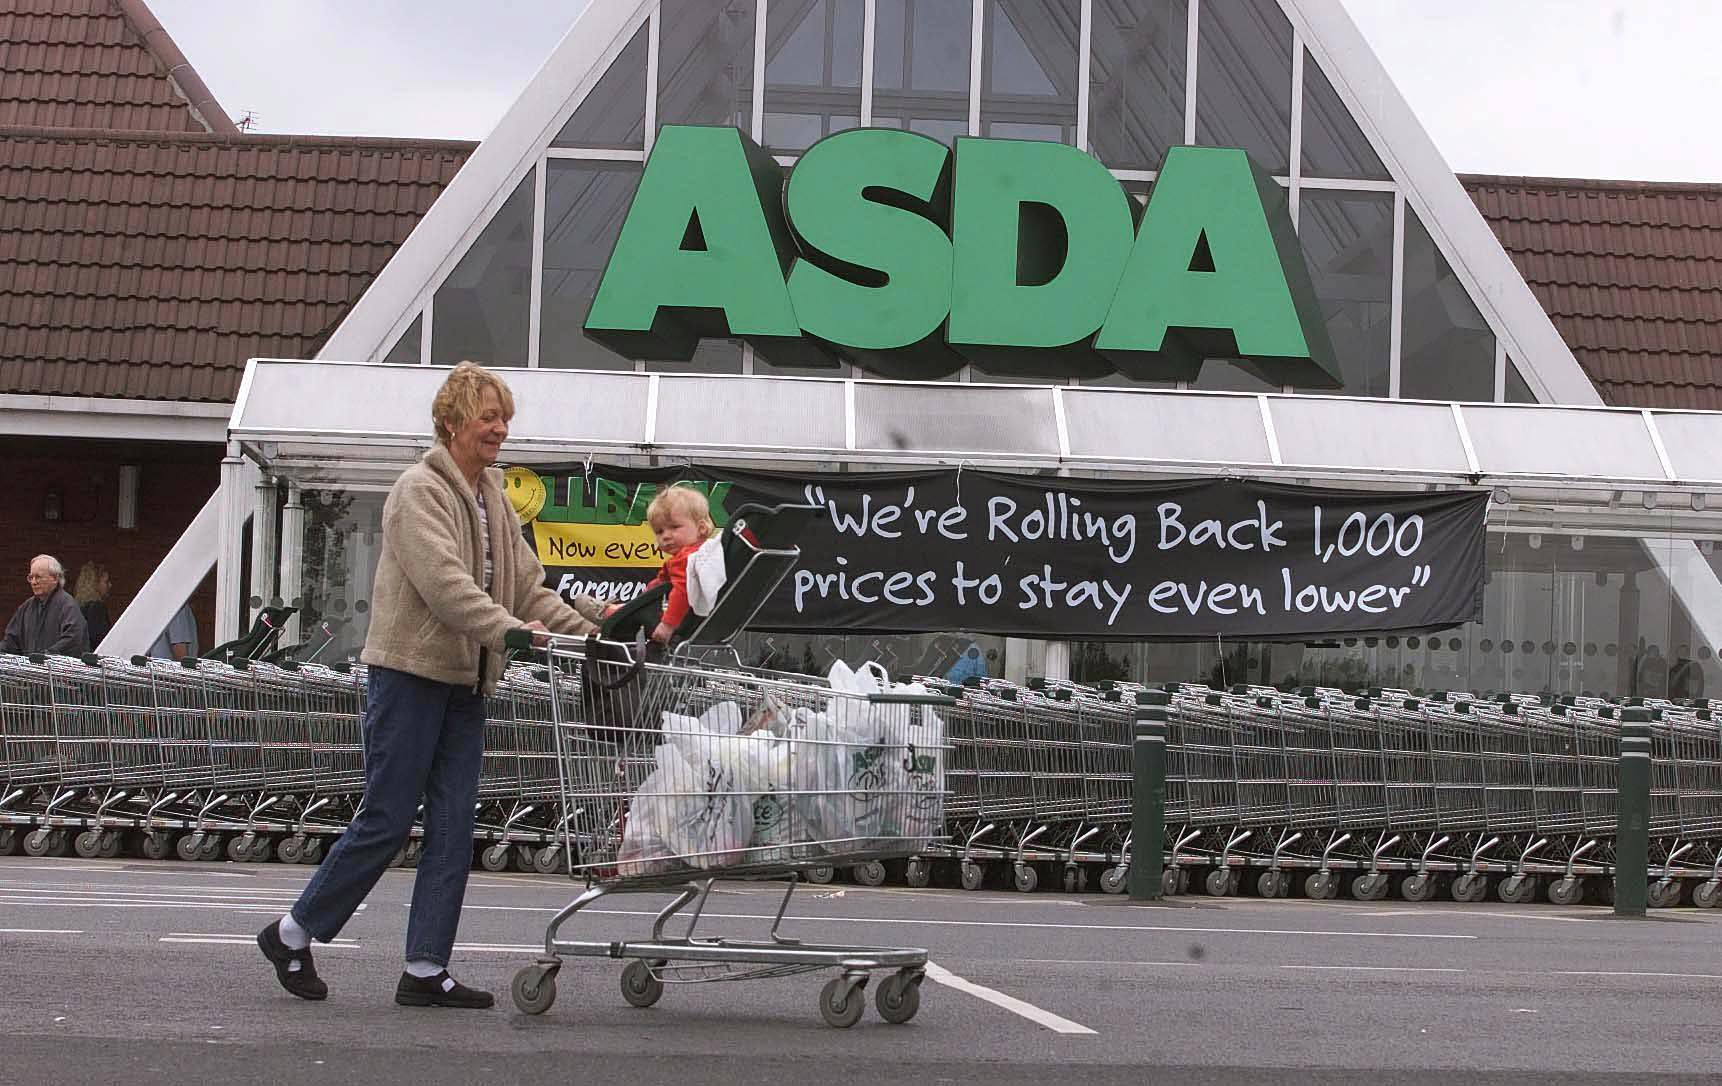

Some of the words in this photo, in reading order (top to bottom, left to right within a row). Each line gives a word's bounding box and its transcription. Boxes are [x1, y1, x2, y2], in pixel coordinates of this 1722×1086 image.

[583, 124, 1314, 362] ASDA
[549, 536, 596, 560] Now
[604, 540, 665, 560] even
[804, 485, 968, 538] "We're
[988, 492, 1136, 563] Rolling
[1157, 500, 1287, 552] Back
[1314, 505, 1424, 563] 1,000
[557, 573, 647, 602] Forever
[794, 557, 936, 613] prices
[952, 561, 1003, 606] to
[1019, 564, 1132, 625] stay
[1148, 581, 1267, 616] even
[1282, 565, 1431, 614] lower"
